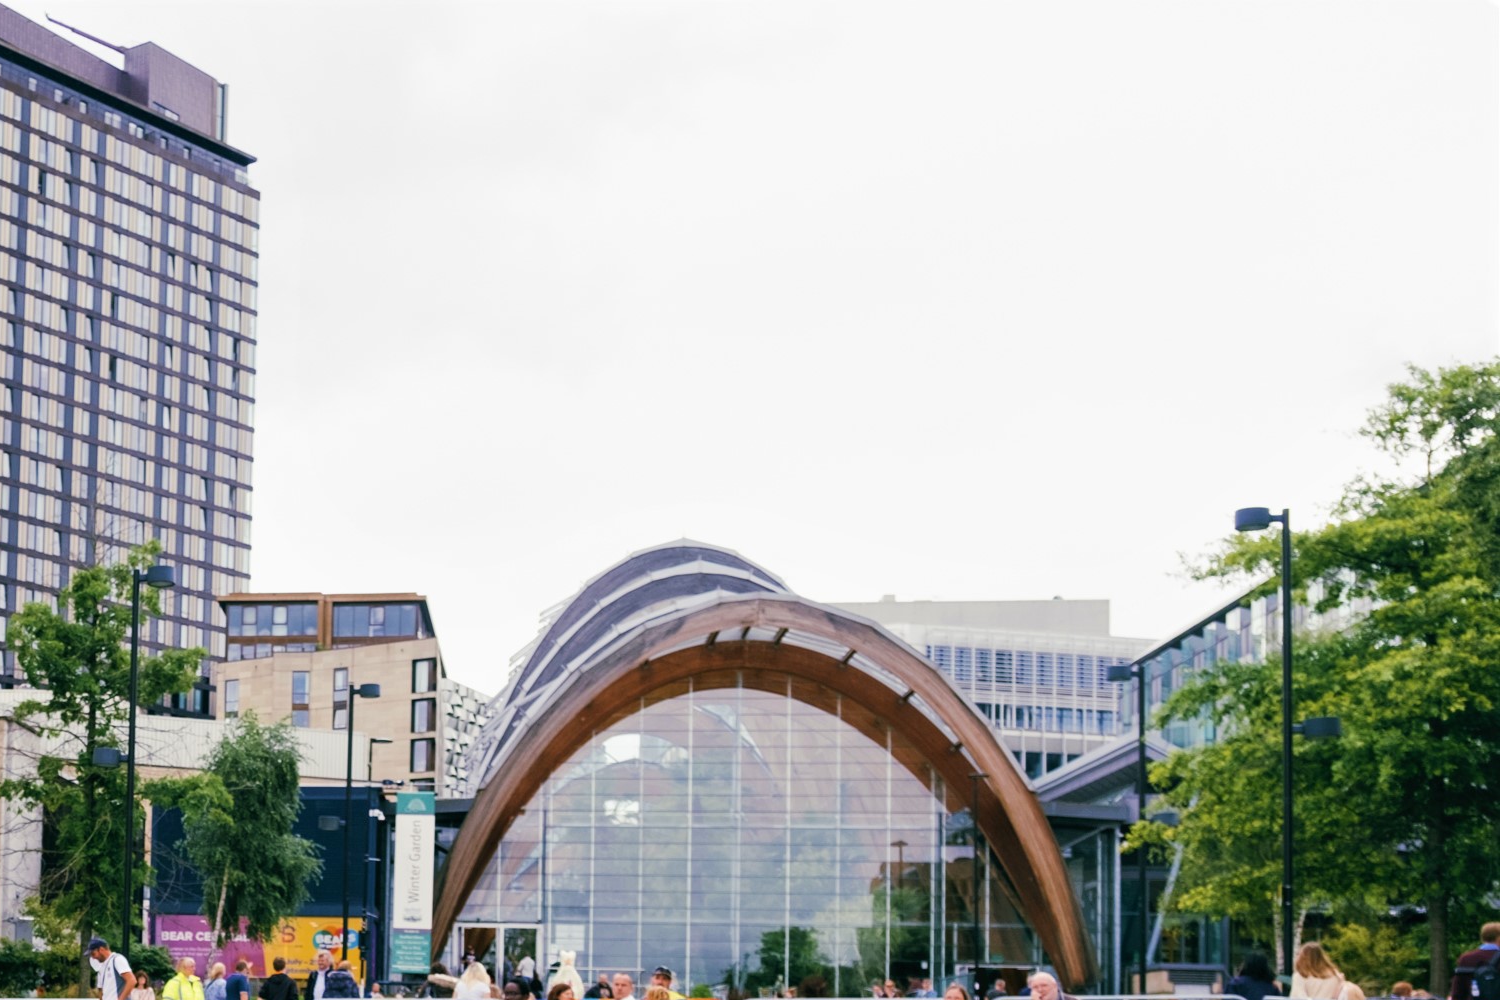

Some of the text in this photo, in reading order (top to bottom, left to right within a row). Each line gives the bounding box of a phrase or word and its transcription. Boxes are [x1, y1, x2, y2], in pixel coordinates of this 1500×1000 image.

[408, 820, 421, 862] Garden
[408, 865, 420, 903] Winter
[161, 931, 193, 941] BEAR
